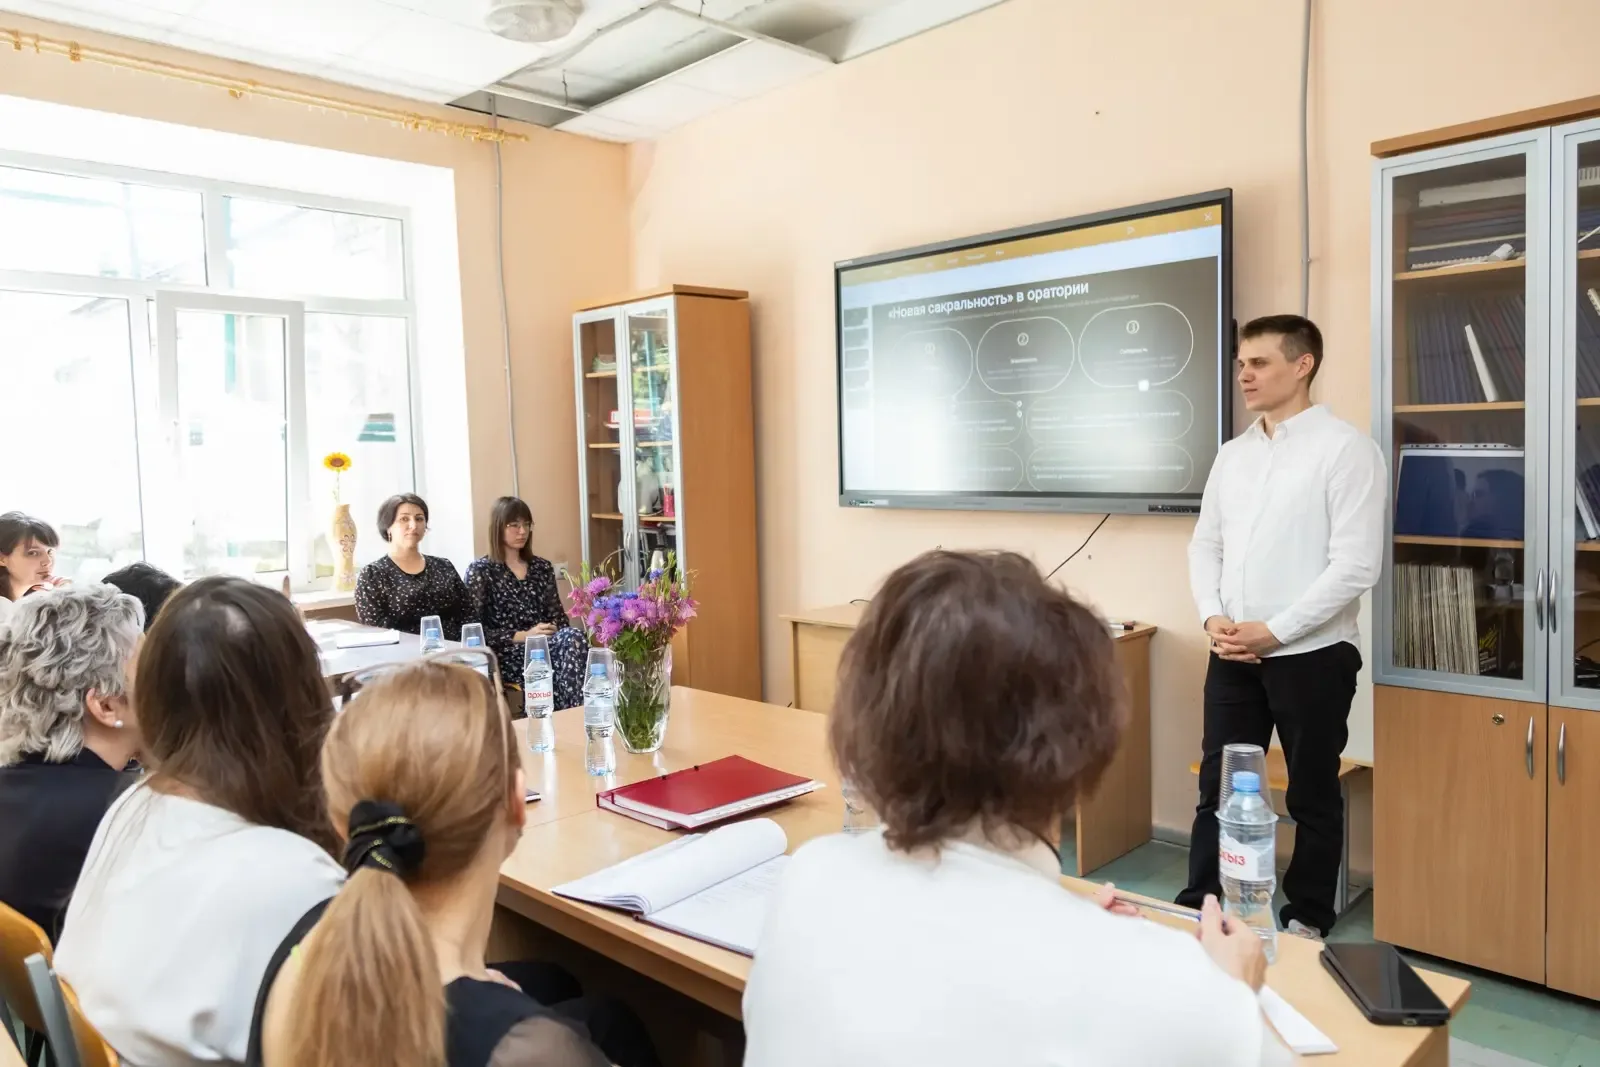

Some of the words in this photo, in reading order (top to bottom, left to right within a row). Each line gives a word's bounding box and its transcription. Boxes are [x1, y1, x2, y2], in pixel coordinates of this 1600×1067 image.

[888, 305, 926, 319] «Новая
[928, 293, 1013, 315] сакральность»
[1016, 292, 1024, 302] в
[1027, 282, 1089, 303] оратории
